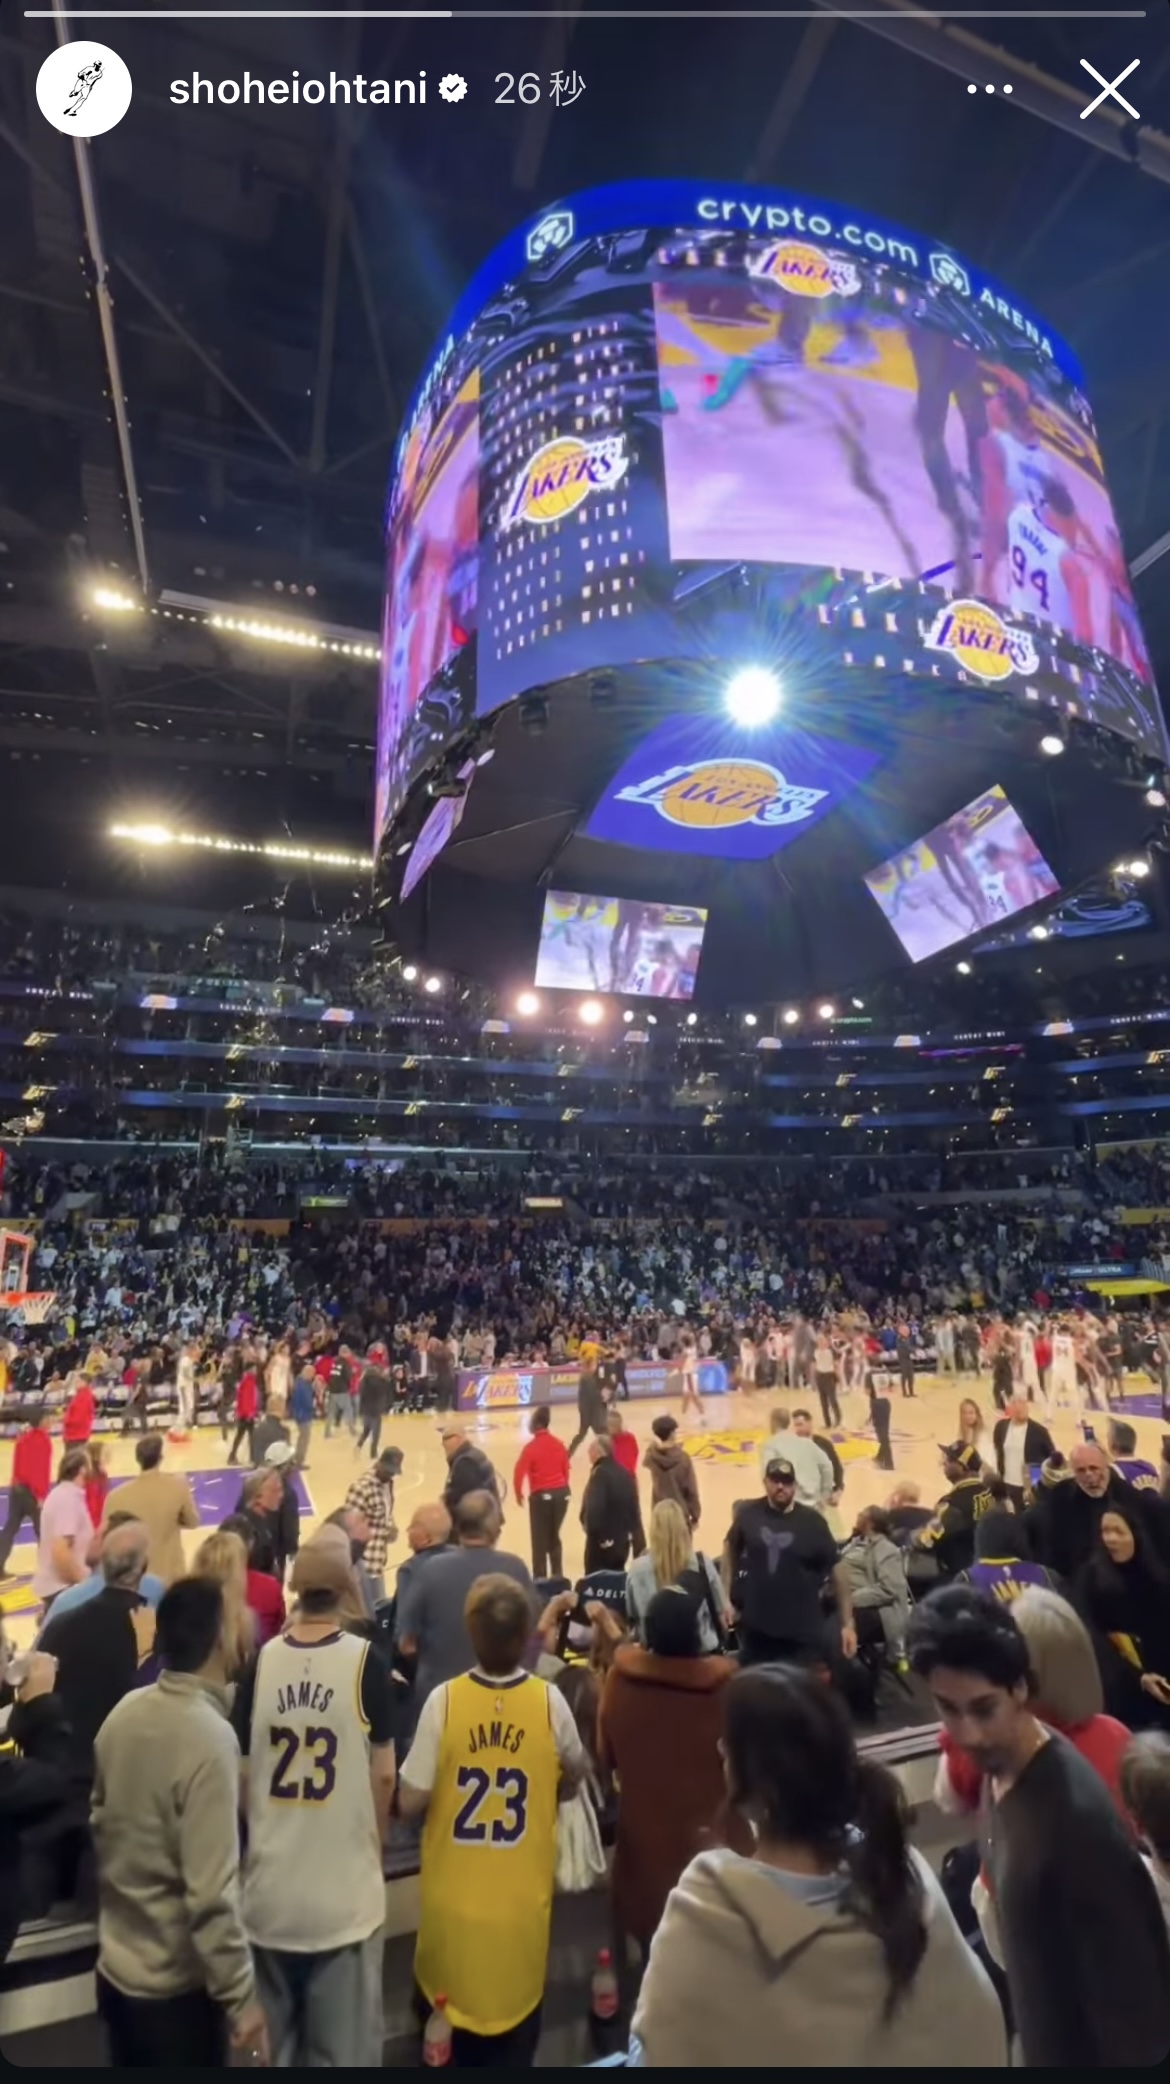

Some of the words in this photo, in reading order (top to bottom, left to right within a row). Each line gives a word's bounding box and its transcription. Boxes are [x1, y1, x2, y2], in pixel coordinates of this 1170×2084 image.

[697, 198, 919, 268] crypto.com
[979, 287, 1055, 359] ARENA
[1012, 545, 1051, 613] 94
[934, 613, 1036, 671] LAKERS
[633, 770, 807, 822] LAKERS
[596, 1587, 626, 1599] DELT
[277, 1681, 335, 1715] JAMES
[268, 1725, 339, 1803] 23
[468, 1720, 526, 1754] JAMES
[452, 1765, 530, 1844] 23
